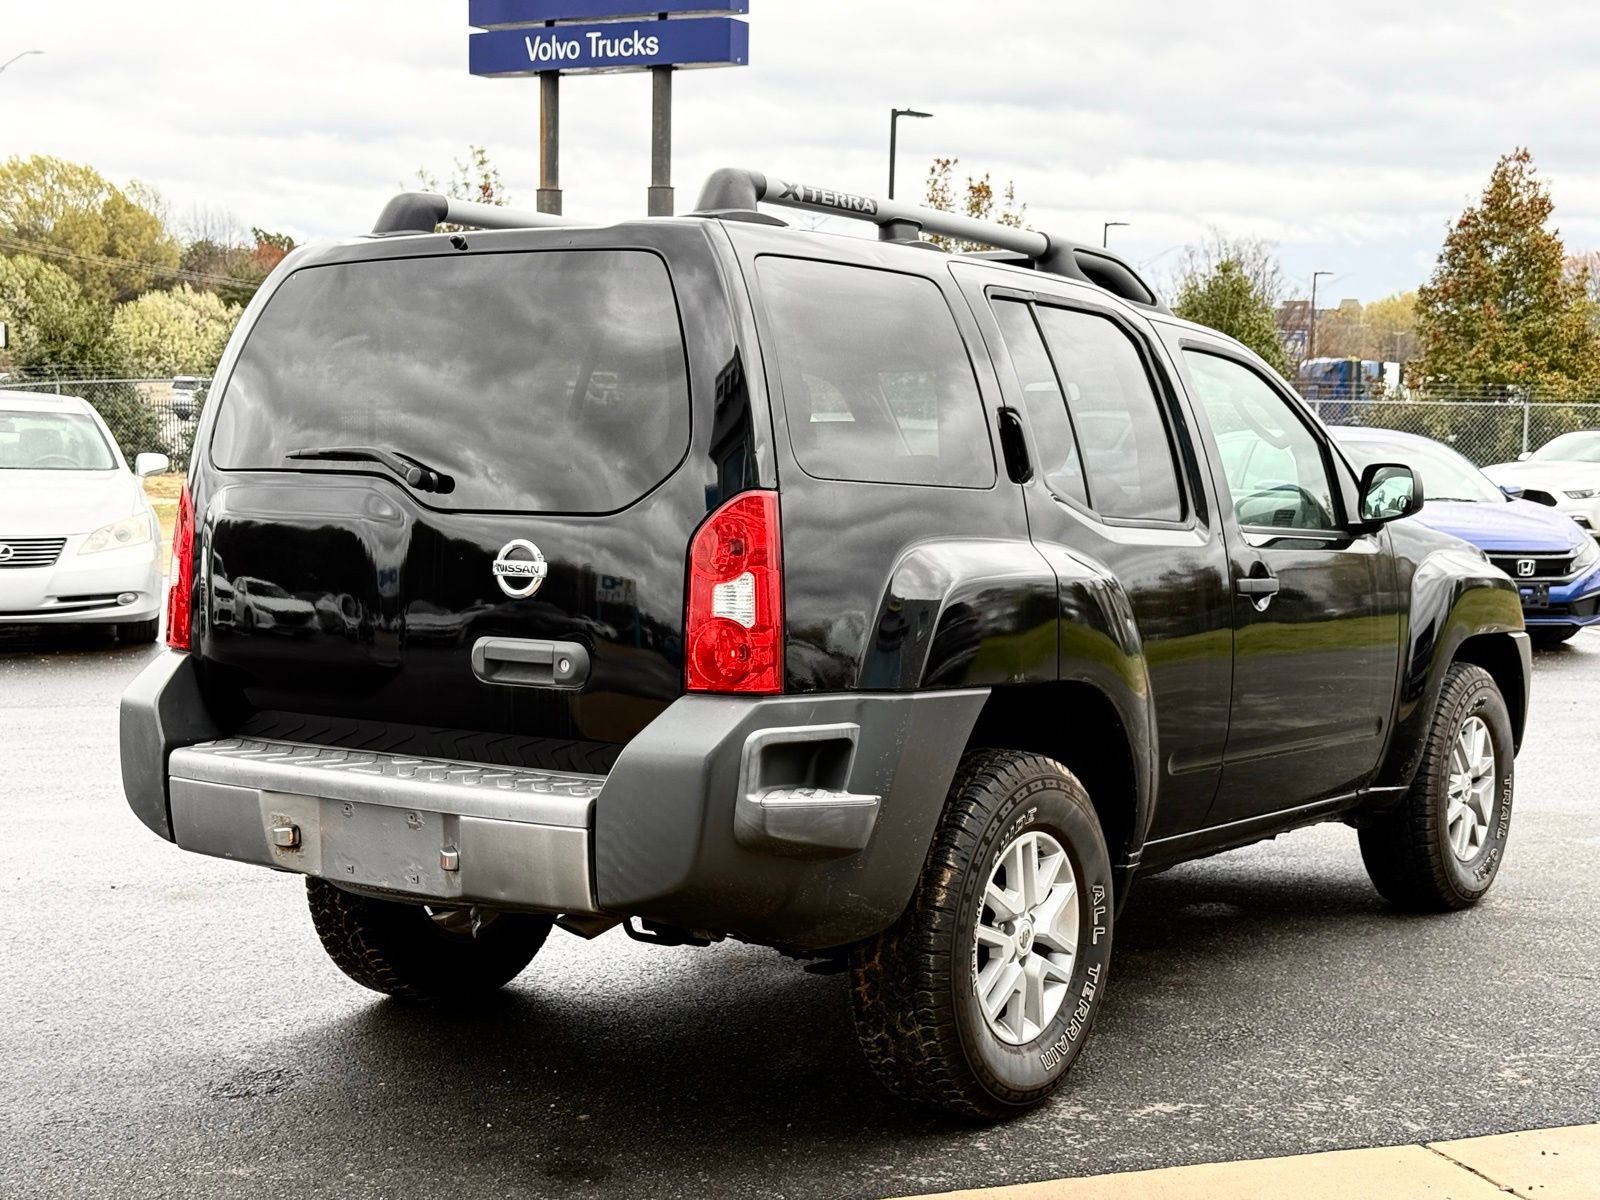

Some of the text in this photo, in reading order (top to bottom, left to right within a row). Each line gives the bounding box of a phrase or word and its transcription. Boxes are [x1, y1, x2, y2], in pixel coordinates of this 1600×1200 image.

[525, 30, 659, 62] Volvo Trucks
[778, 179, 878, 215] XTERRA
[495, 563, 540, 574] NISSAN
[1040, 885, 1106, 1070] ALL TERRAIN
